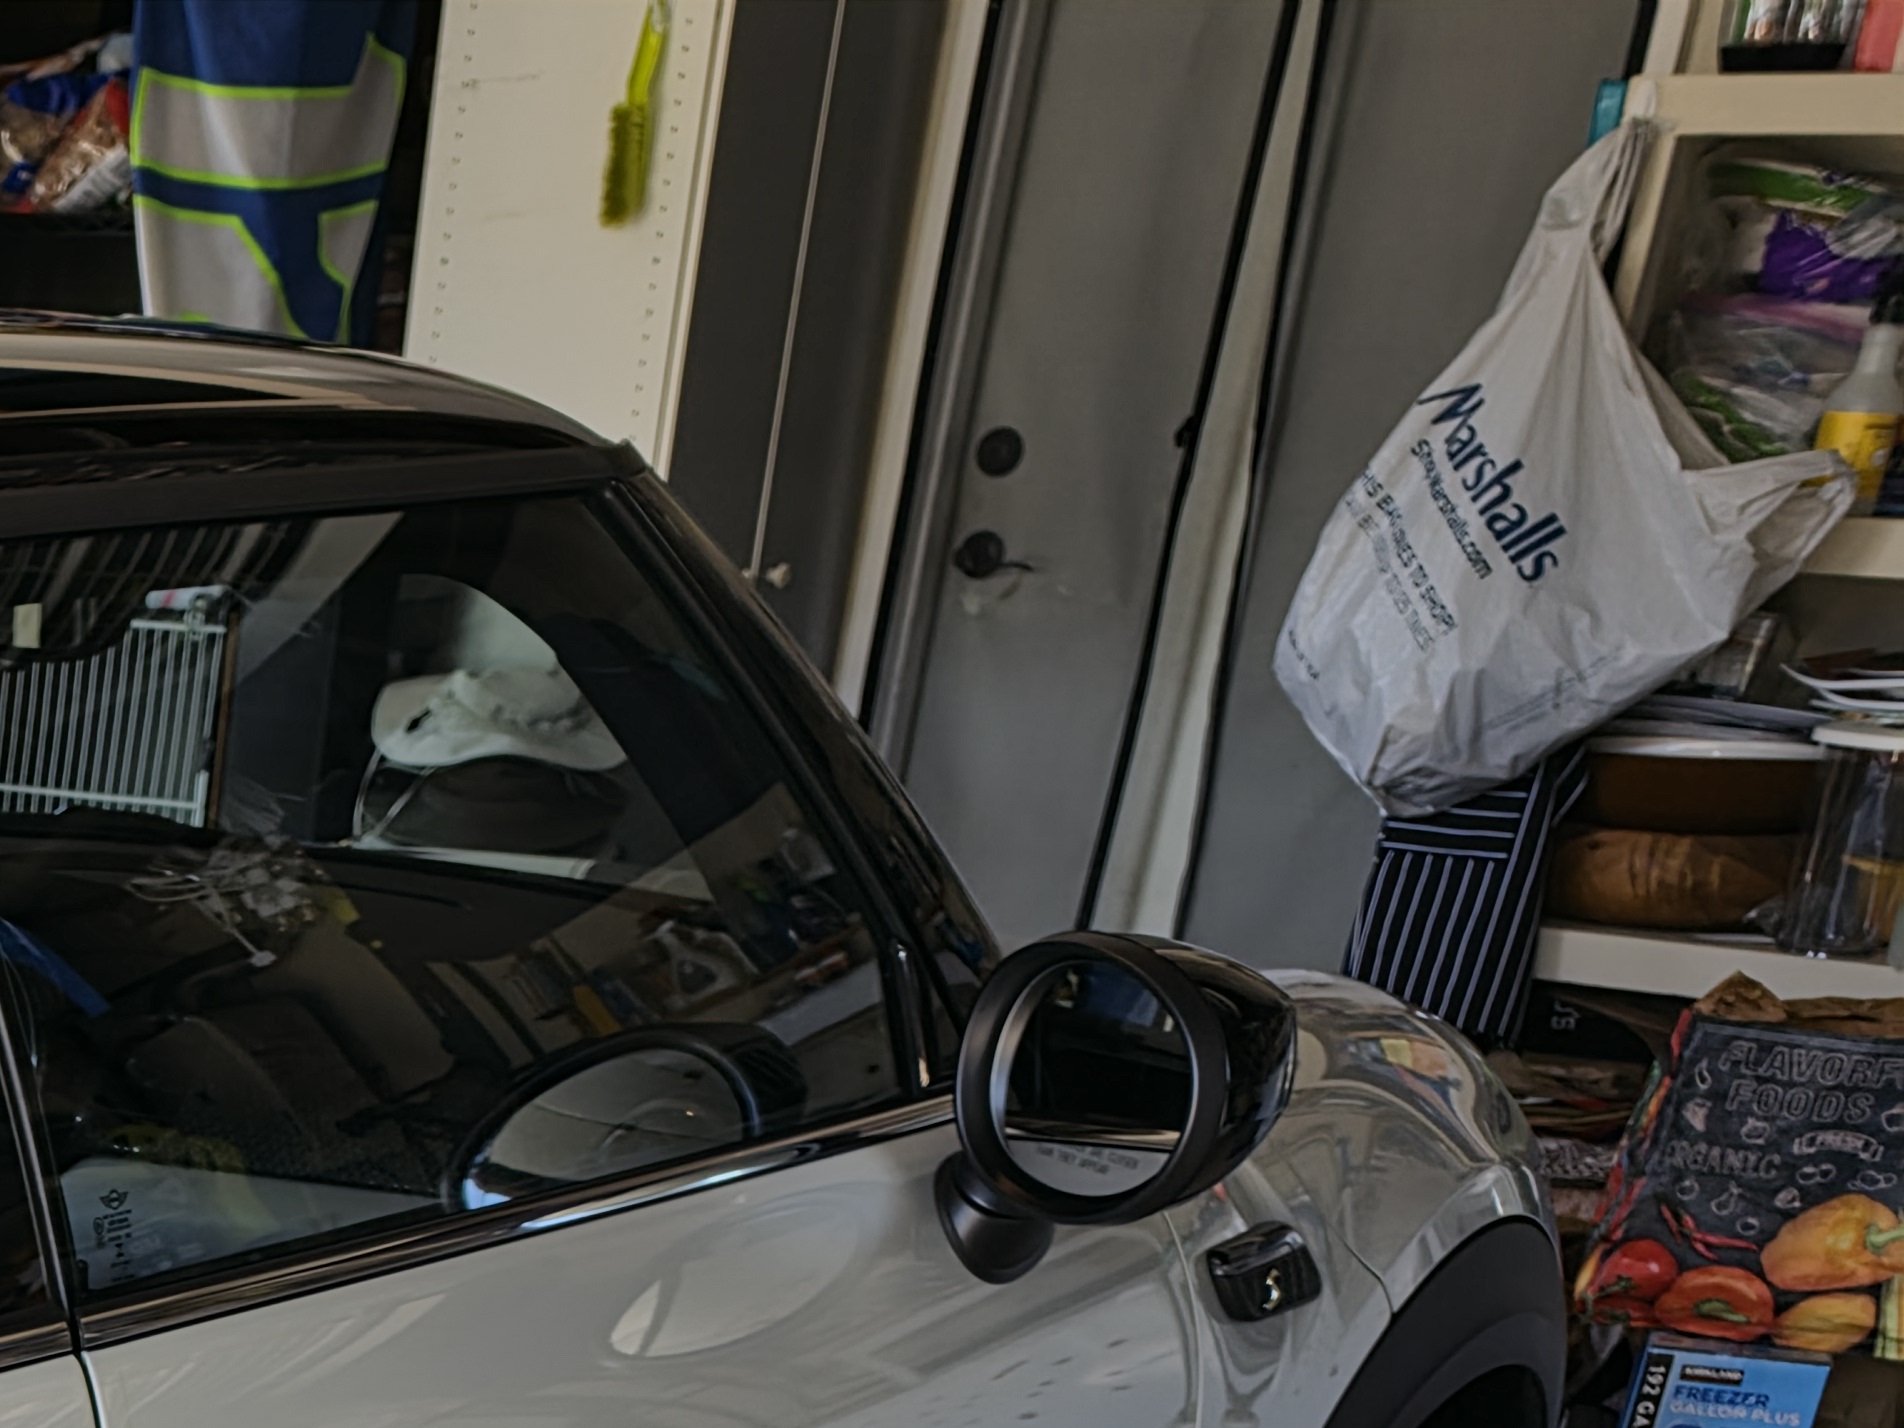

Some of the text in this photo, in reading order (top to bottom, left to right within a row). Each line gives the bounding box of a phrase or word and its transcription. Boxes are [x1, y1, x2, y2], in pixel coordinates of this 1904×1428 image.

[1415, 382, 1567, 583] Marshalls
[1724, 1078, 1877, 1125] FOODS
[1641, 1364, 1667, 1397] 192
[1672, 1384, 1770, 1408] FREEZER
[1669, 1400, 1801, 1428] GALLON PLUS
